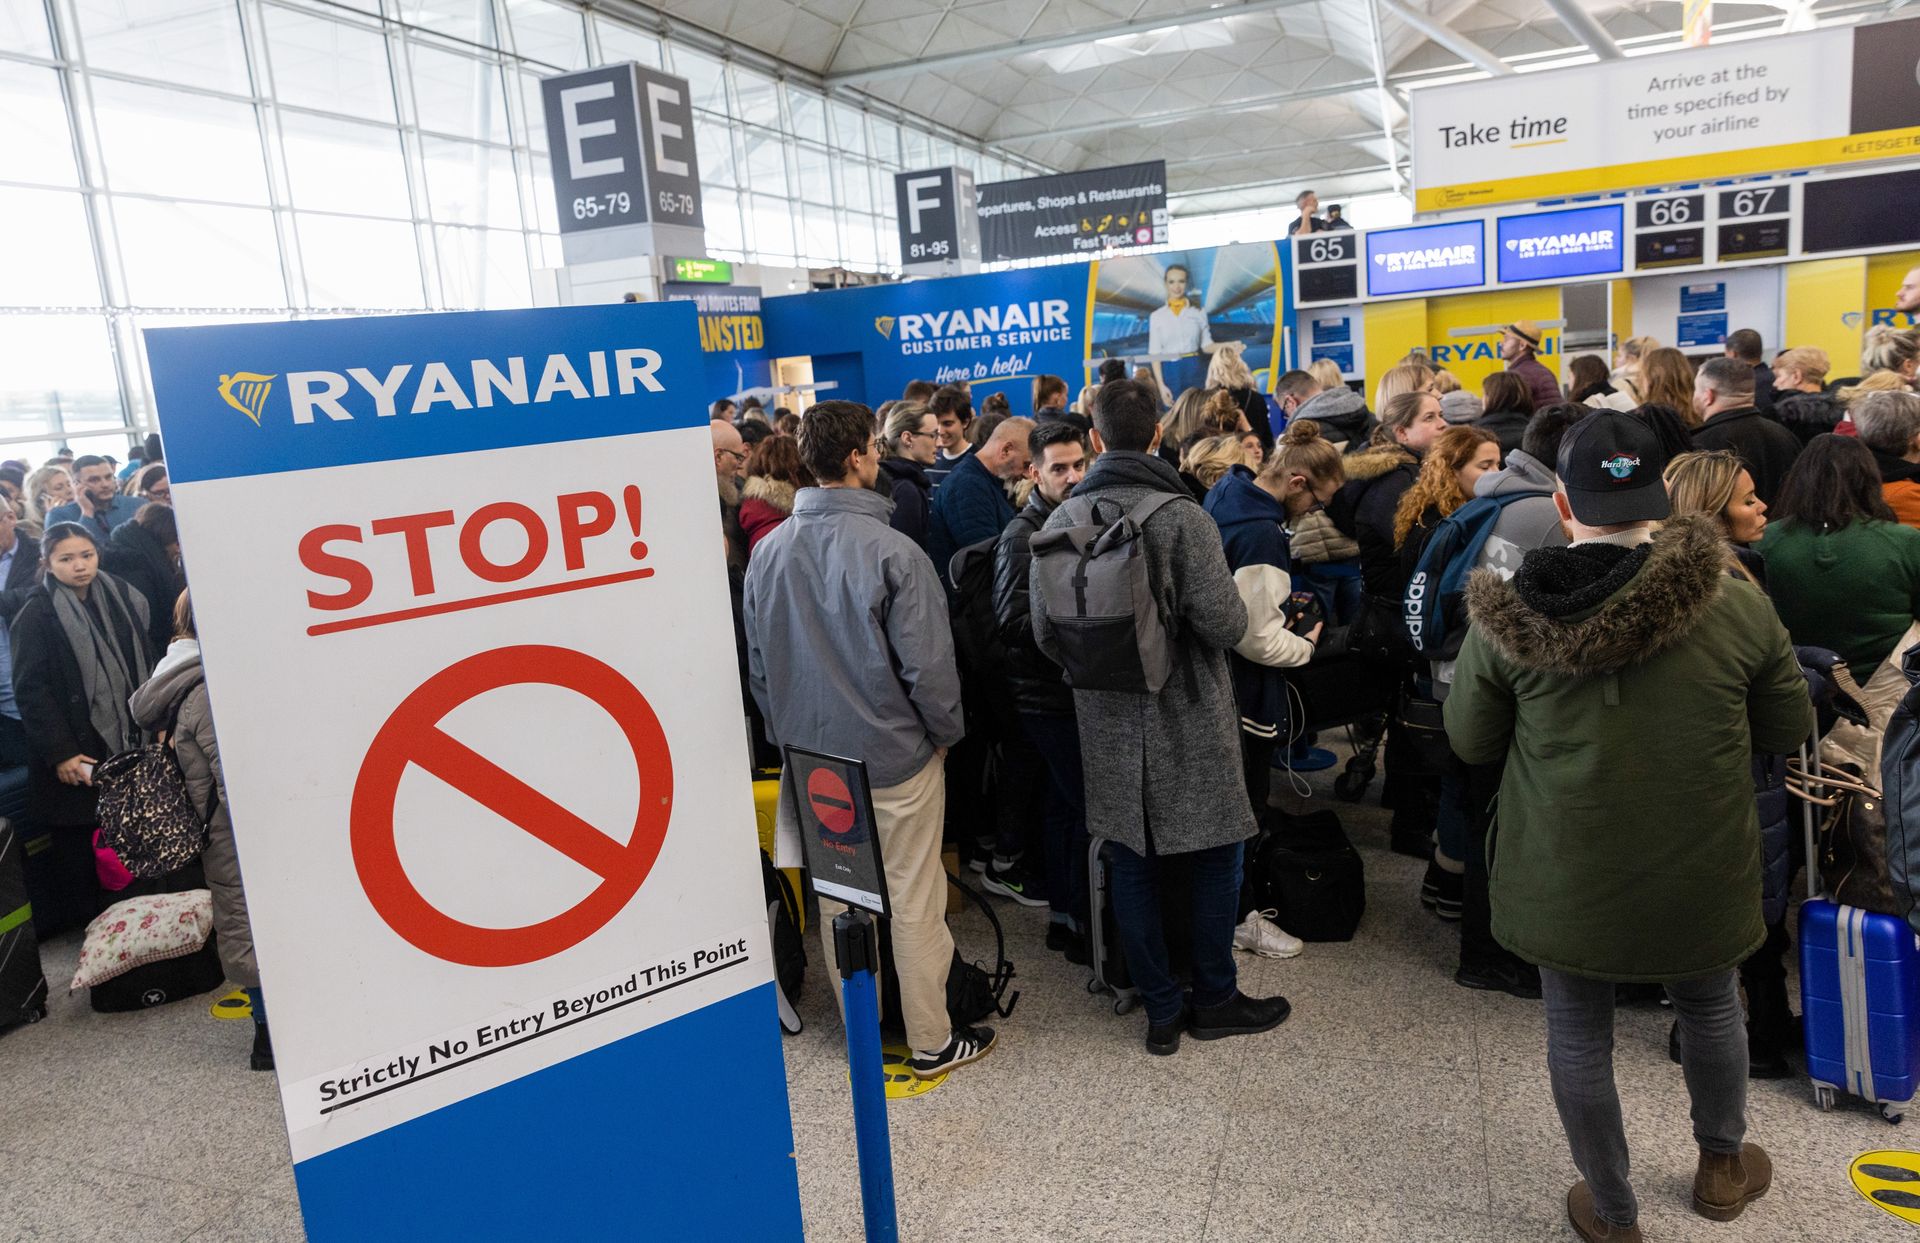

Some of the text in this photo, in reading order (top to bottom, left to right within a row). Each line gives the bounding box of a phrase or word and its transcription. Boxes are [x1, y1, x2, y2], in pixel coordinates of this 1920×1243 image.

[1648, 62, 1769, 93] Arrive at the
[1627, 85, 1790, 120] time specified by
[560, 81, 625, 180] E
[647, 81, 690, 178] E
[1438, 116, 1568, 149] Take time
[1653, 113, 1760, 144] your airline
[573, 191, 631, 220] 65-79
[659, 191, 694, 216] 65-79
[906, 175, 942, 234] F
[977, 183, 1162, 217] epartures, Shops & Restaurants
[1650, 198, 1690, 226] 66
[1733, 188, 1776, 217] 67
[1034, 222, 1078, 238] Access
[1073, 232, 1133, 250] Fast Track
[1519, 229, 1614, 252] RYANAIR
[910, 240, 950, 258] 81-95
[1310, 237, 1344, 262] 65
[1386, 244, 1475, 267] RYANAIR
[698, 315, 764, 352] ANSTED
[899, 299, 1070, 341] RYANAIR
[901, 326, 1072, 356] CUSTOMER SERVICE
[935, 351, 1033, 384] Here to help!
[286, 348, 666, 425] RYANAIR
[1601, 457, 1641, 468] Hard Rock
[298, 484, 650, 611] STOP!
[1405, 571, 1427, 651] adidas
[823, 838, 834, 849] No
[319, 937, 748, 1103] Strictly No Entry Beyond This Point
